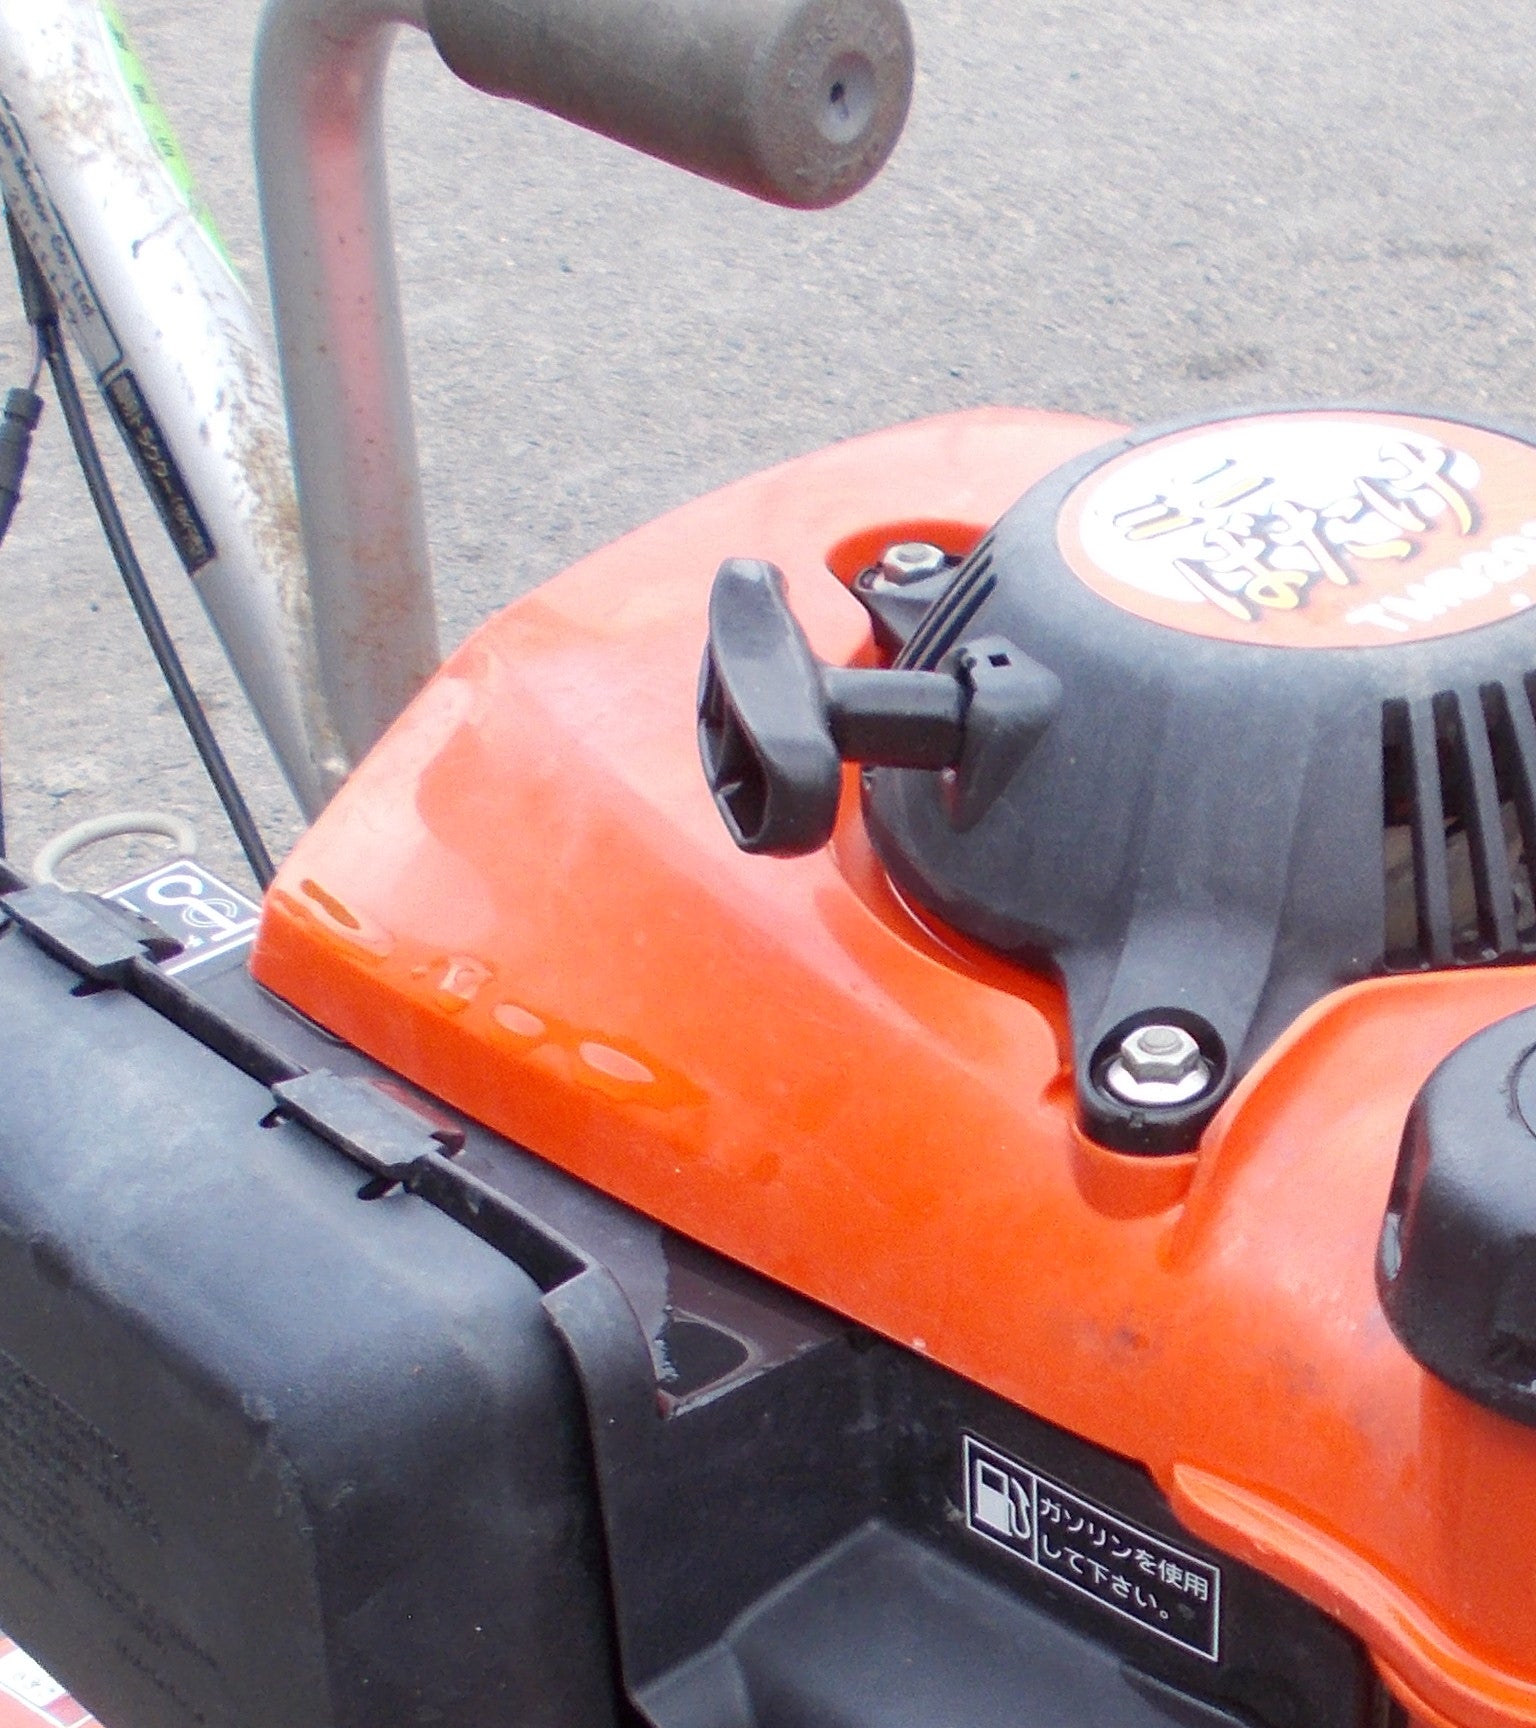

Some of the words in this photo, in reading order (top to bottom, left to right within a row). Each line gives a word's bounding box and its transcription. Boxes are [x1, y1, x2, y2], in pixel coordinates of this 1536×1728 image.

[1040, 1496, 1209, 1601] ガソリンを使用
[1042, 1533, 1169, 1619] して下さい。
